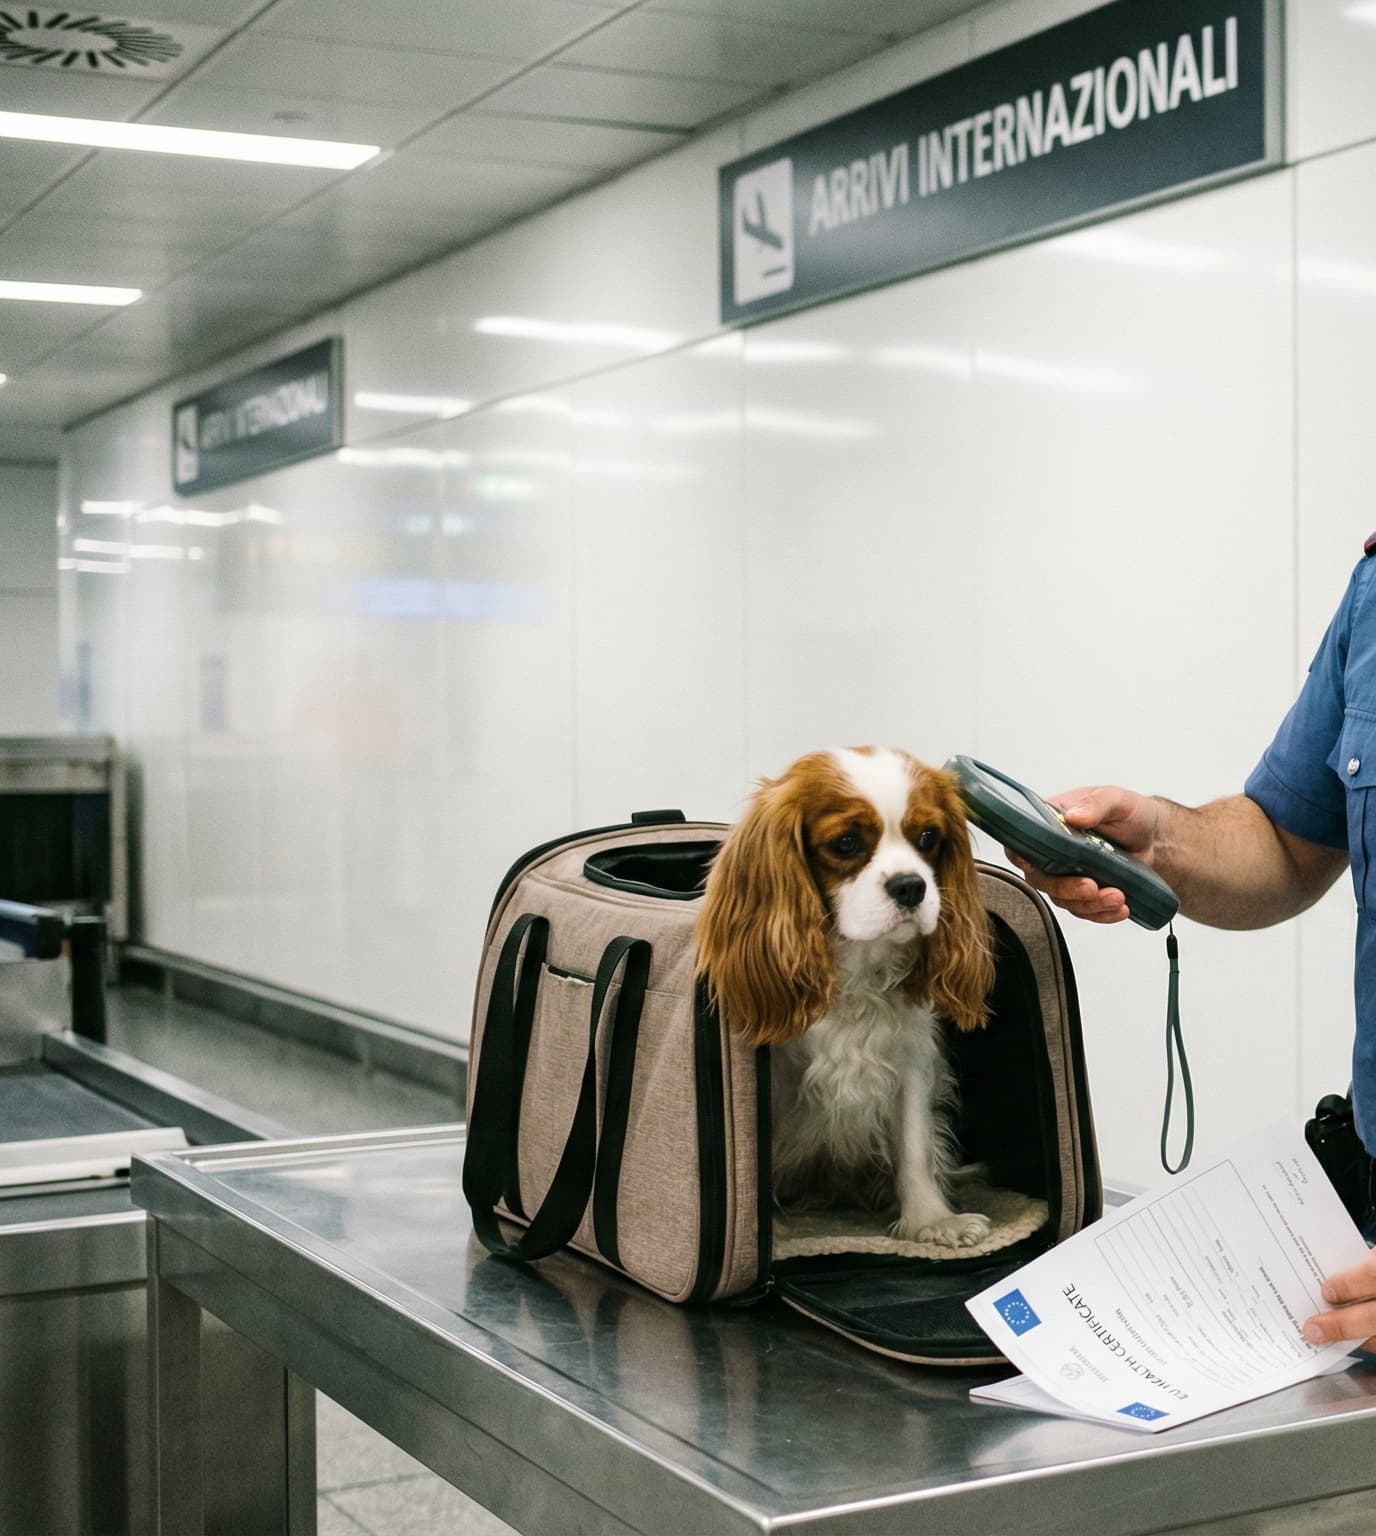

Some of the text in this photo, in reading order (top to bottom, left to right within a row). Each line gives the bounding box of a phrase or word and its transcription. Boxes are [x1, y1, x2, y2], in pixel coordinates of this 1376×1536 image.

[808, 17, 1238, 235] ARRIVI INTERNAZIONALI
[1062, 1282, 1127, 1358] CERTIFICATE
